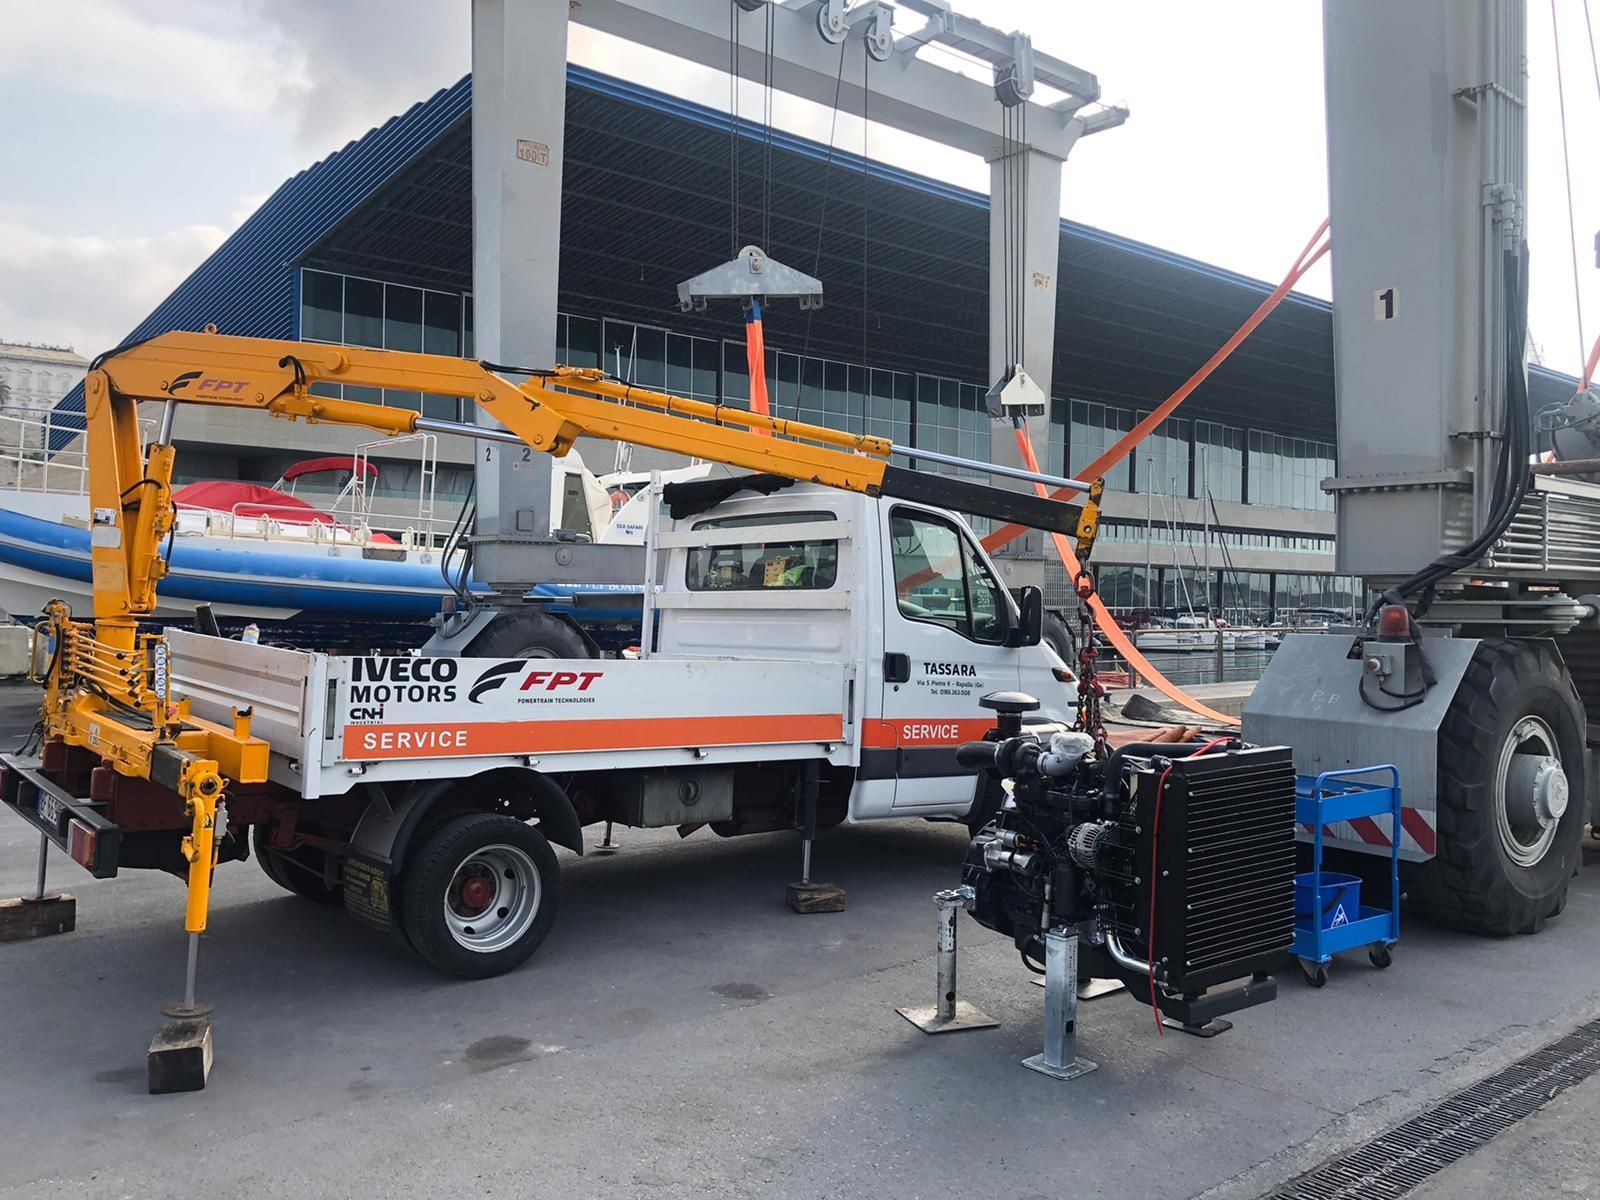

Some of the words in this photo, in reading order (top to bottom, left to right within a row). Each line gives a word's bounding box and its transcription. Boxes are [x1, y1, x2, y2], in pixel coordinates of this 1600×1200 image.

[1380, 288, 1393, 319] 1
[198, 379, 250, 394] FPT
[486, 447, 491, 462] 2
[522, 447, 531, 462] 2
[351, 657, 458, 683] IVECO
[923, 662, 977, 677] TASSARA
[519, 671, 604, 691] FPT
[350, 685, 457, 703] MOTORS
[363, 730, 468, 750] SERVICE
[902, 725, 959, 740] SERVICE
